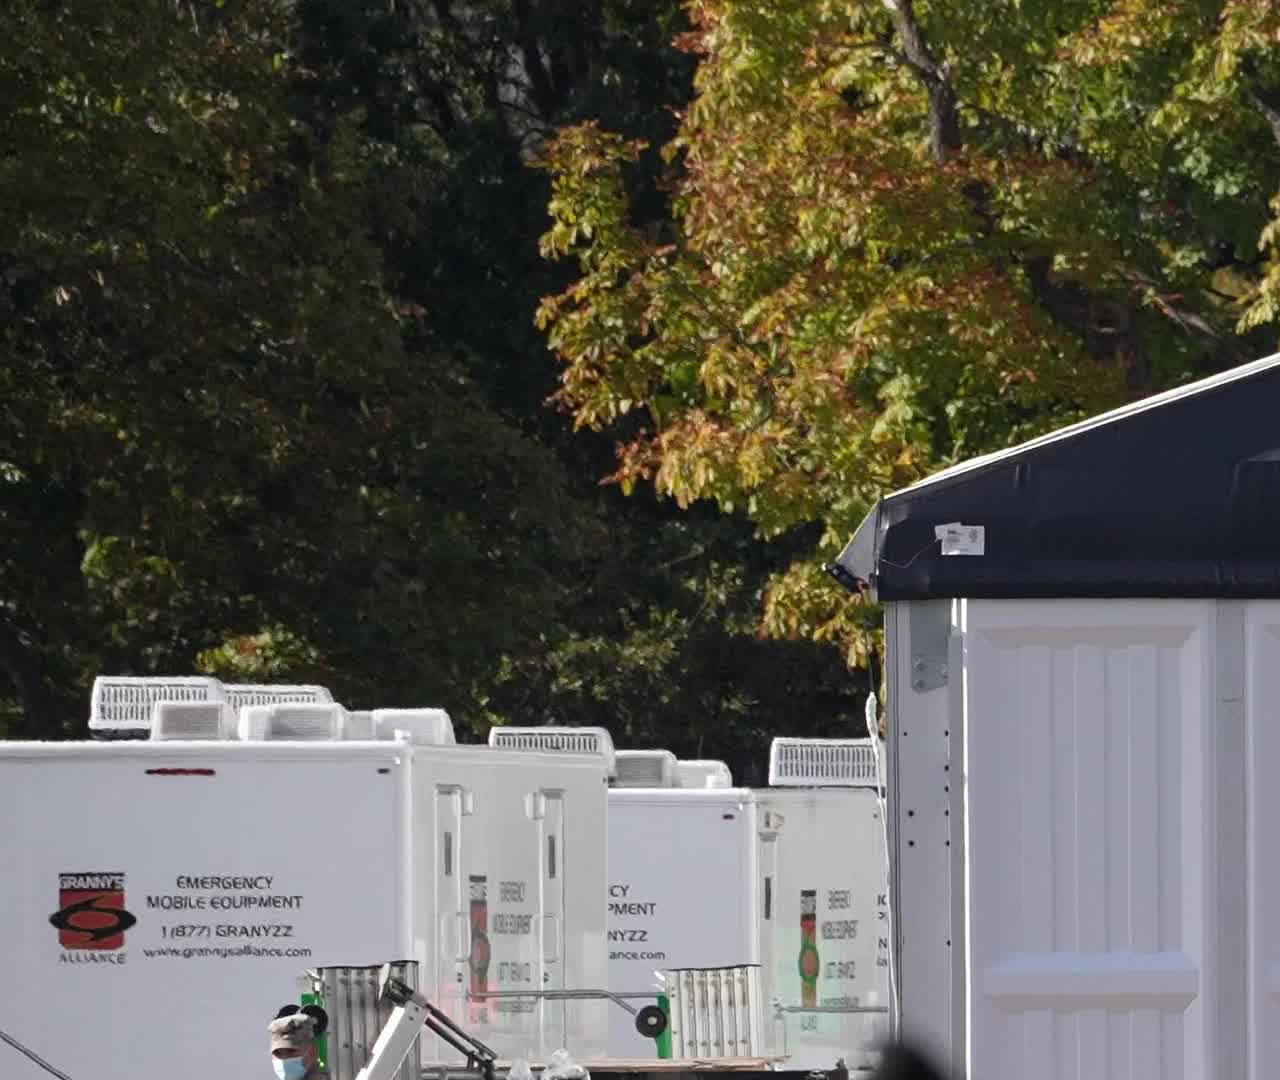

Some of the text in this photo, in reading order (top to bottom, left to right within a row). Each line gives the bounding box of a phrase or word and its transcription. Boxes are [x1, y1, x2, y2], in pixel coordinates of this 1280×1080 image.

[176, 875, 273, 890] EMERGENCY
[146, 895, 304, 910] MOBILE EQUIPMENT
[608, 903, 656, 916] PMENT
[215, 924, 293, 938] GRANYZZ
